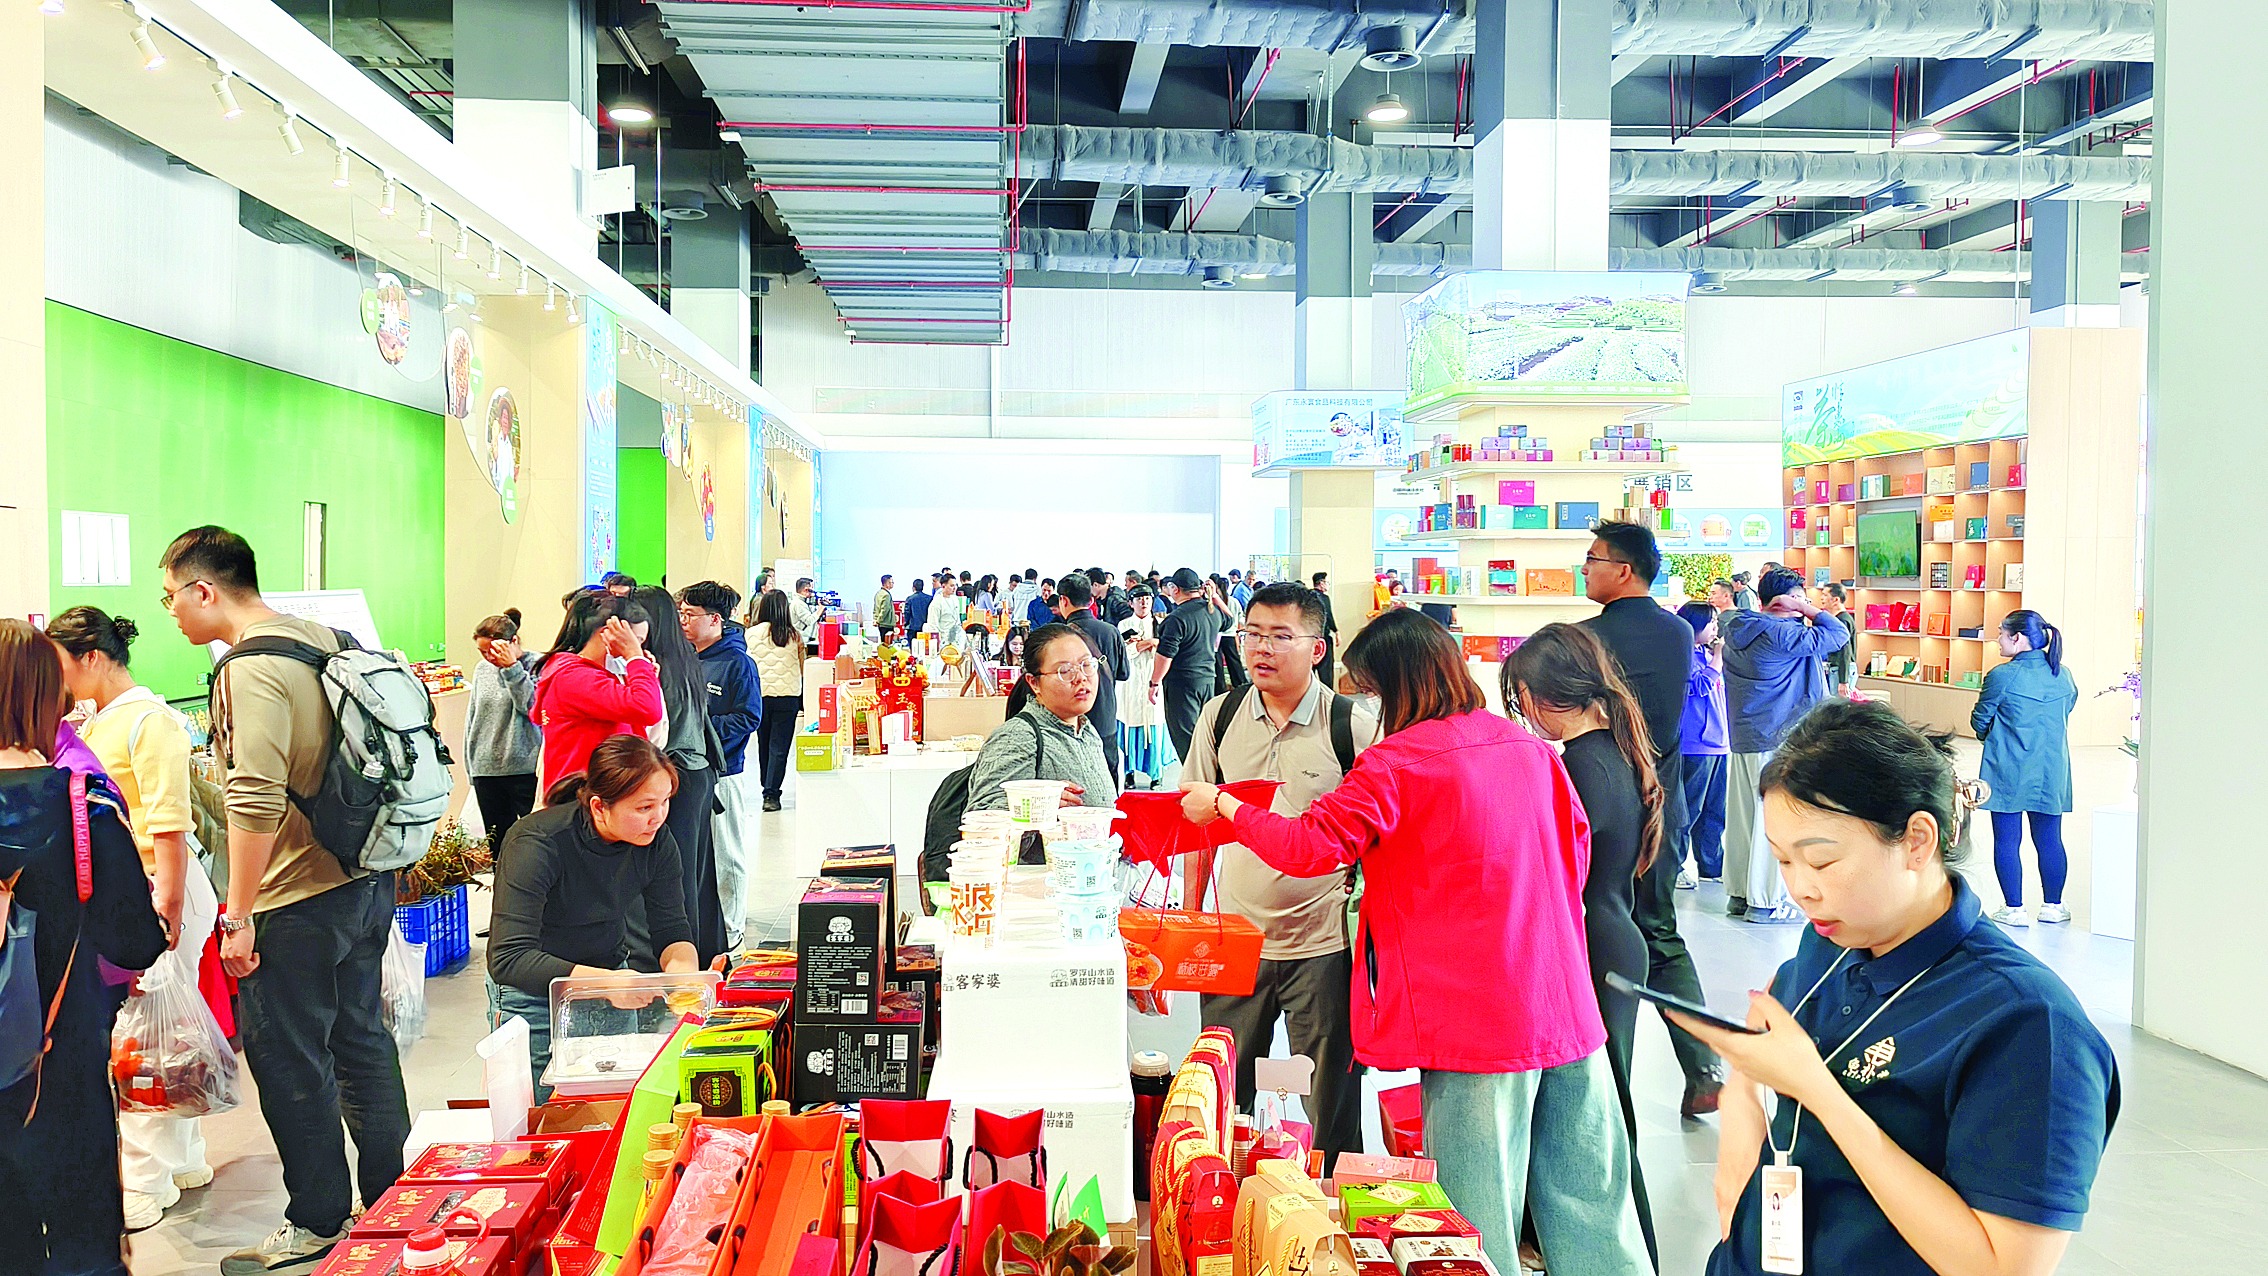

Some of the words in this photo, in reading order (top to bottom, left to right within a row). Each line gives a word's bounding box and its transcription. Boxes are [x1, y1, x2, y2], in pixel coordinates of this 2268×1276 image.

[1625, 474, 1693, 491] 展销区
[74, 799, 86, 825] HAVE
[77, 828, 90, 861] HAPPY
[955, 973, 1001, 990] 客家婆
[1069, 977, 1115, 987] 清甜好味道
